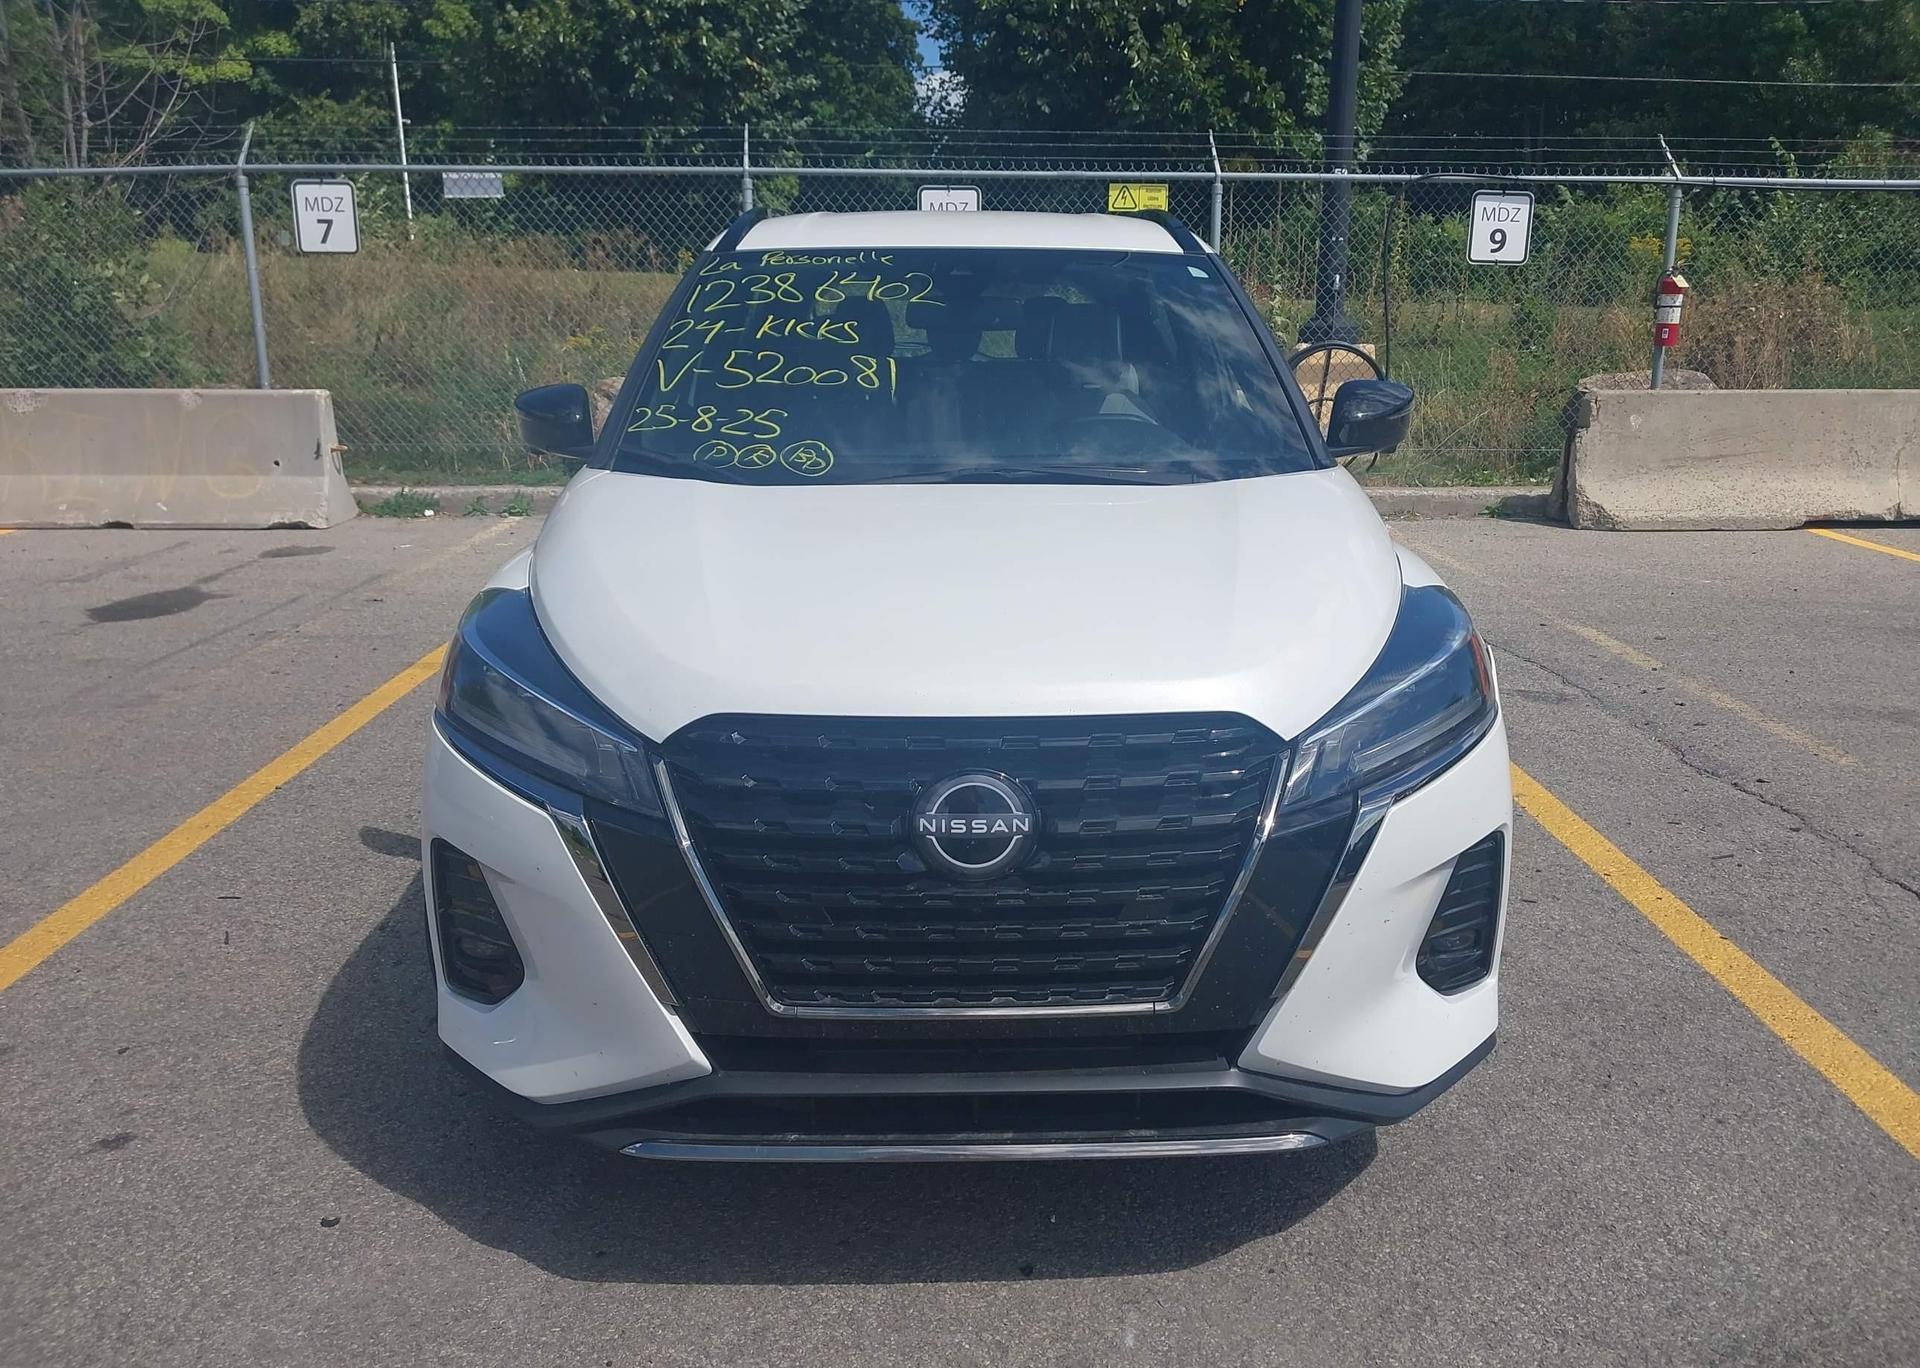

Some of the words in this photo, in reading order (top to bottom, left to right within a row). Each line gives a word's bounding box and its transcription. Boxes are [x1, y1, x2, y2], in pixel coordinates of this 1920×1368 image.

[305, 196, 345, 212] MDZ
[1481, 206, 1521, 223] MDZ
[316, 219, 334, 244] 7
[1489, 228, 1507, 253] 9
[699, 256, 743, 276] La
[627, 404, 789, 439] 25-8-25
[919, 818, 1029, 834] NISSAN
